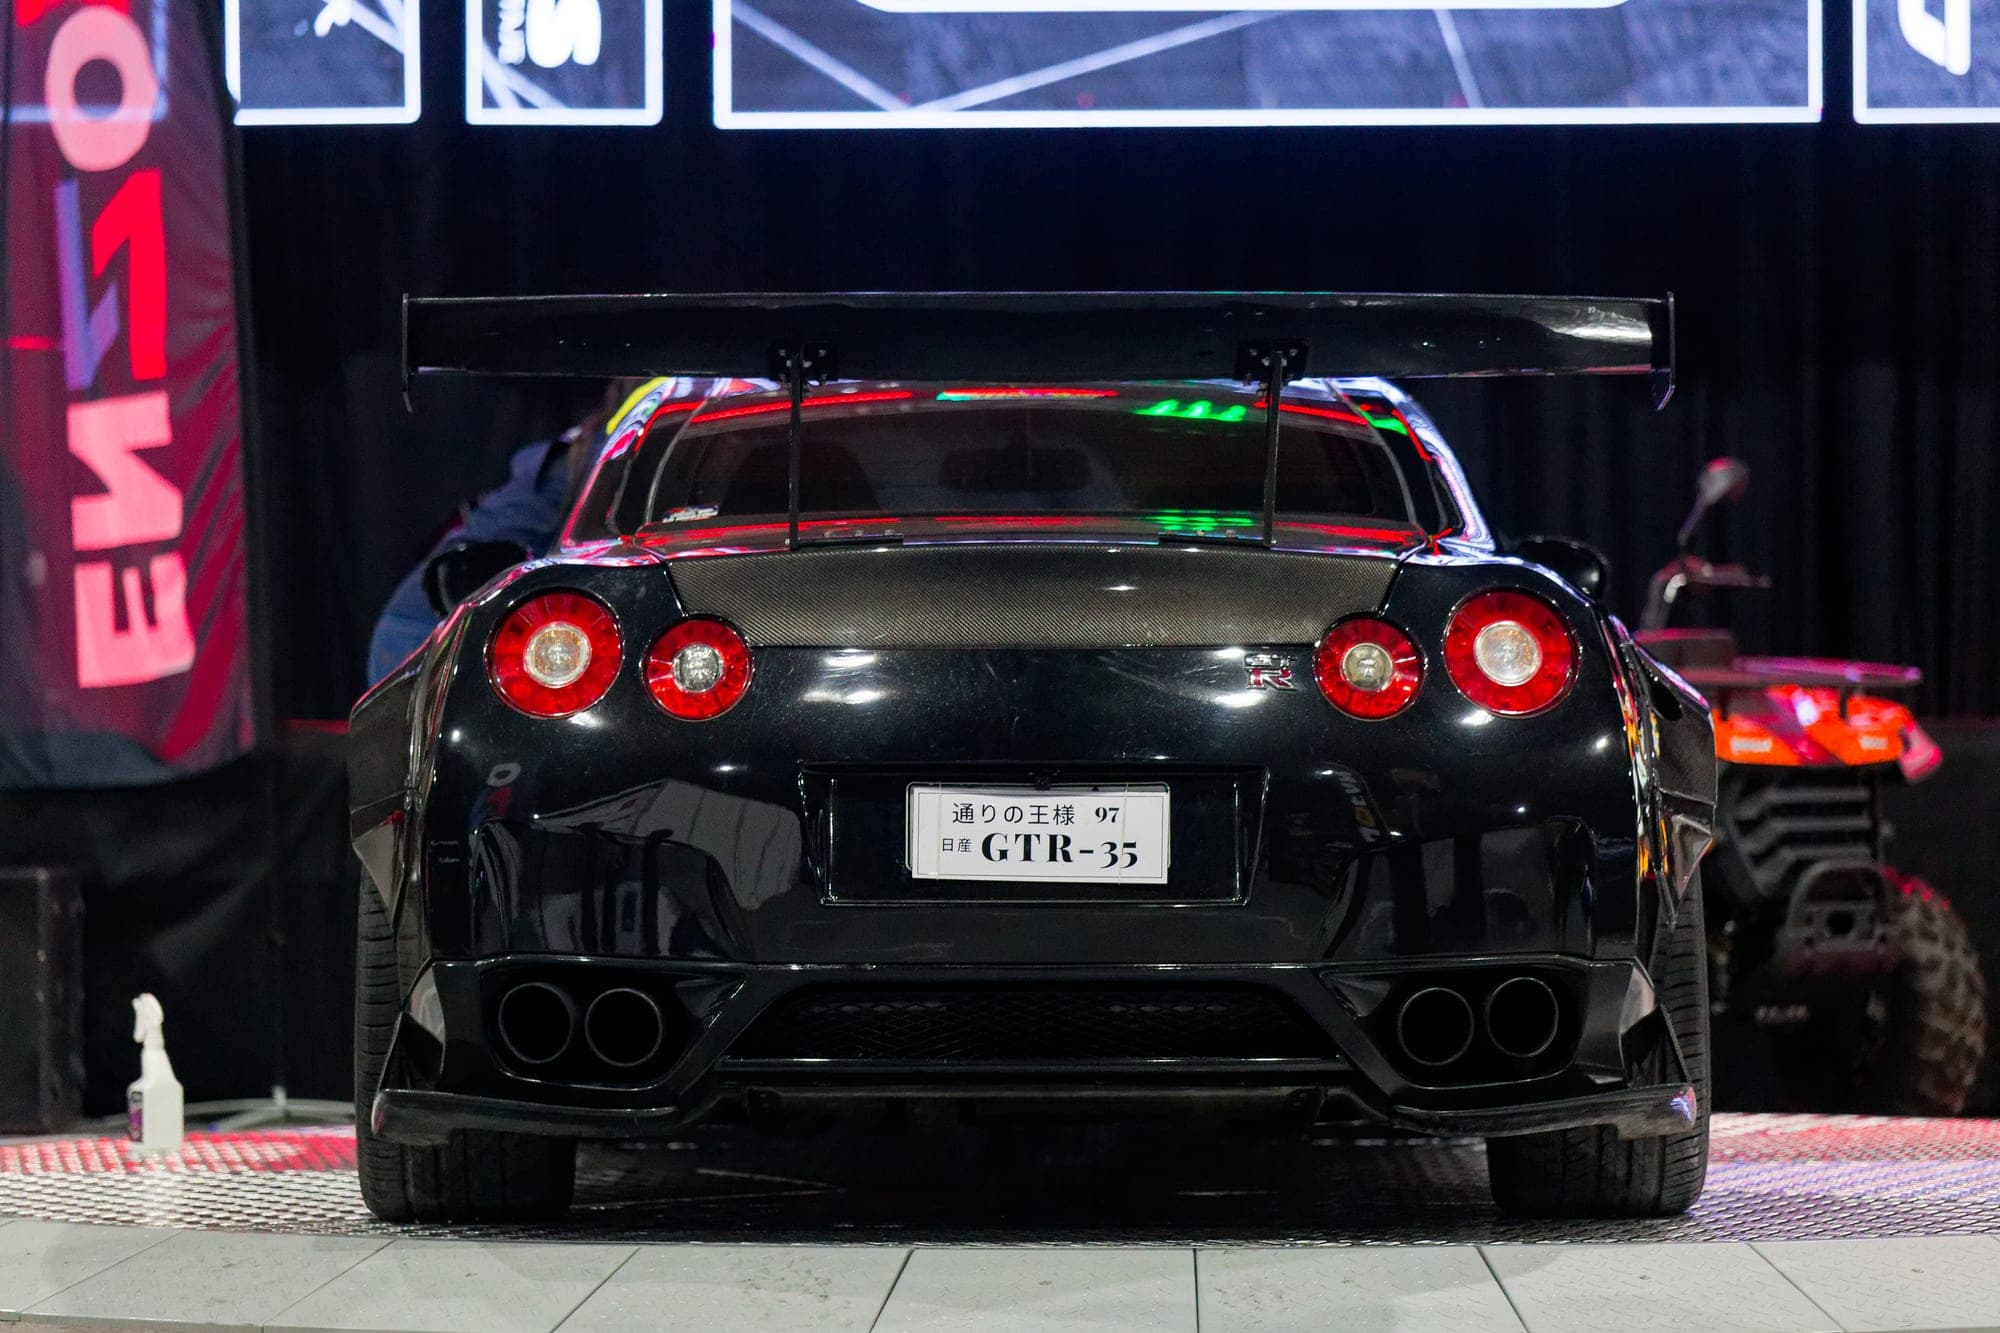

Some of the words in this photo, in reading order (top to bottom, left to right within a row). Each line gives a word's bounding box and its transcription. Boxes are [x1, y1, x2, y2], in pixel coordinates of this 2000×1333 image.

[952, 802, 1075, 826] 通りの王様
[1094, 807, 1120, 824] 97
[941, 838, 972, 853] 日産
[981, 832, 1138, 869] GTR-35
